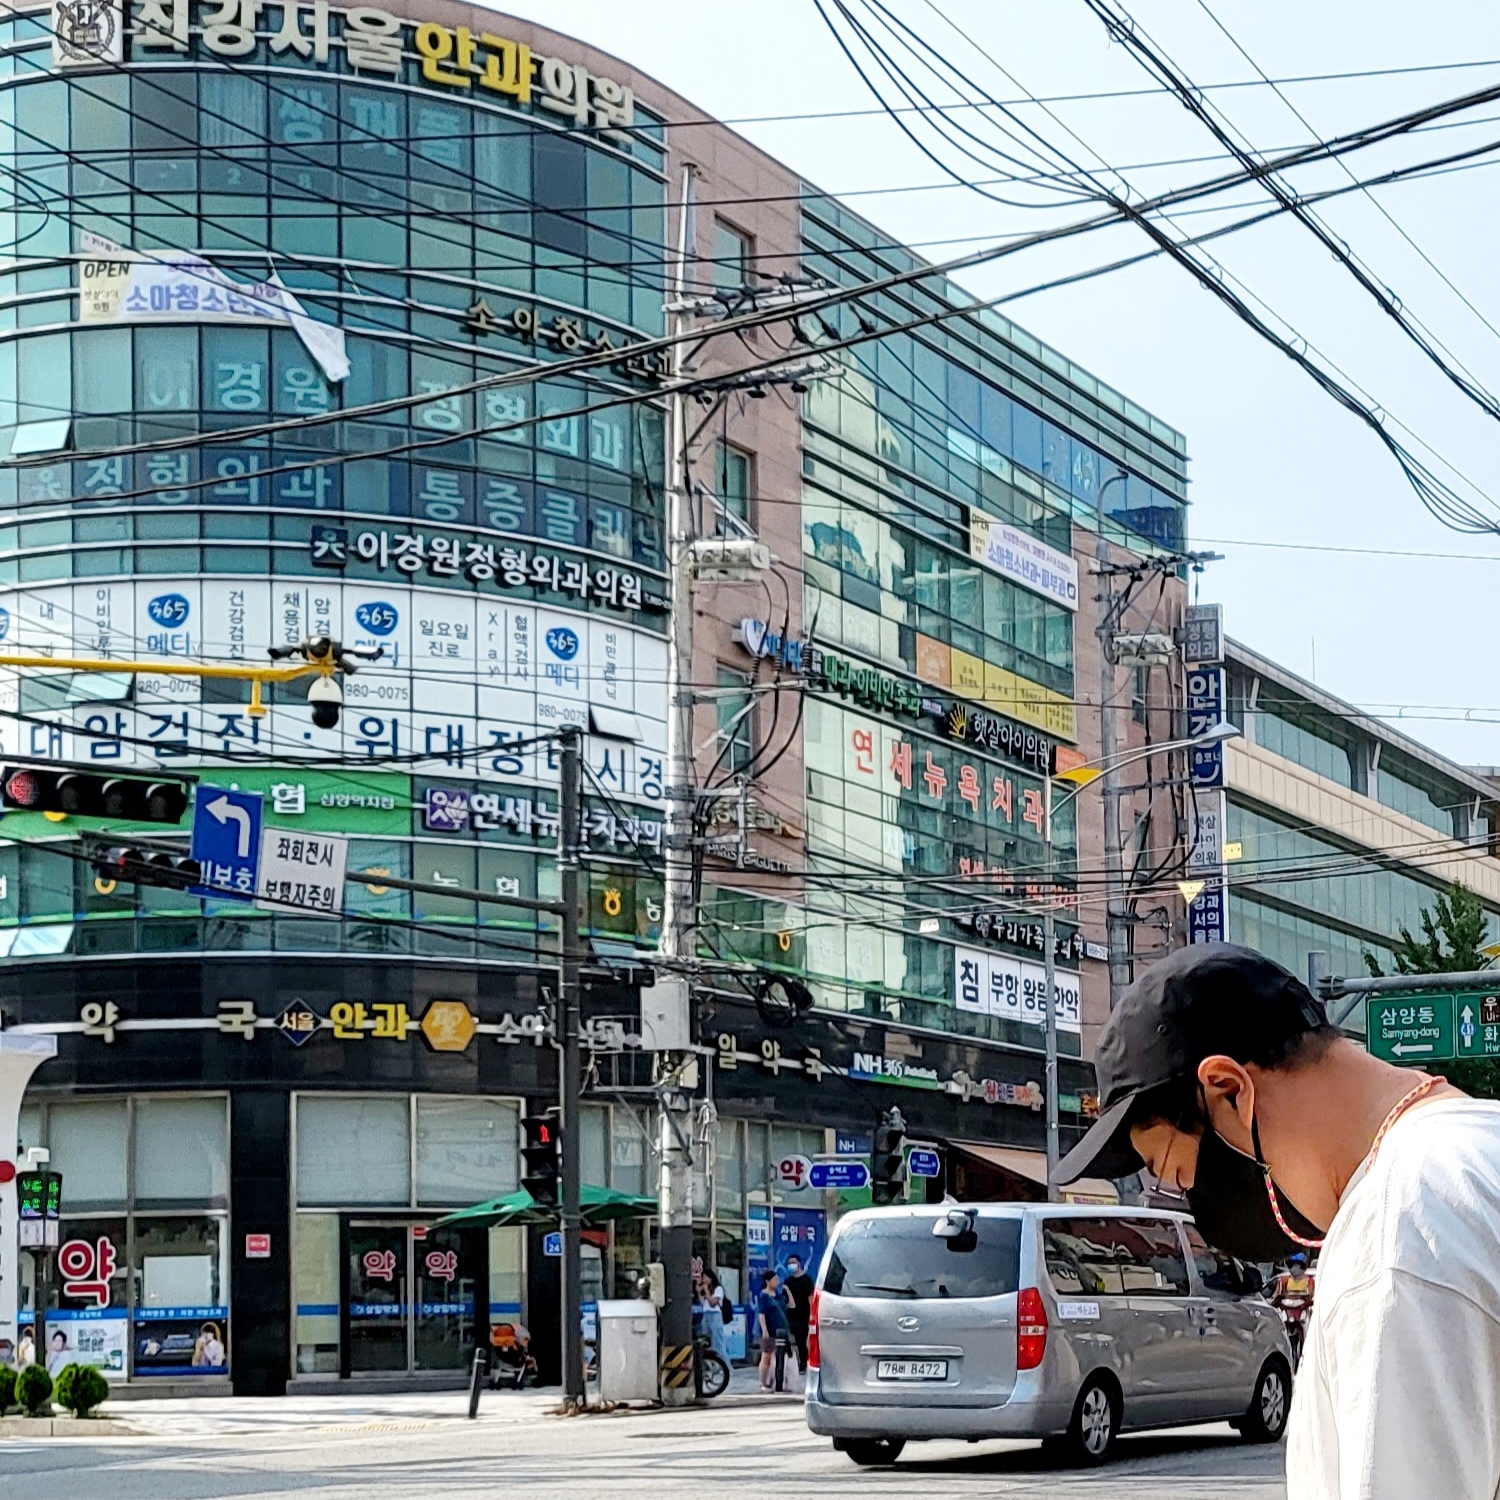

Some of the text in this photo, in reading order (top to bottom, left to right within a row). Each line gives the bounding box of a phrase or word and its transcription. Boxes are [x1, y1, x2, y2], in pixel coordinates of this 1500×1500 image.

[84, 263, 130, 279] OPEN
[357, 533, 643, 610] 이경원정형외과의원
[150, 599, 188, 622] 365
[360, 606, 395, 629] 365
[419, 620, 469, 639] 일요일
[147, 631, 190, 656] 메디
[428, 641, 461, 658] 진료
[548, 631, 577, 654] 365
[545, 663, 580, 690] 메디
[974, 712, 1050, 770] 햇살아이의원
[0, 711, 663, 799] 대암검진 위대장시경
[853, 728, 1045, 834] 연세뉴욕치과
[277, 837, 334, 867] 좌회전시
[706, 843, 738, 861] PARIS
[265, 880, 336, 910] 보행자주의
[960, 960, 979, 1003] 침
[991, 971, 1019, 1006] 부항
[280, 1010, 315, 1032] 서울
[331, 1002, 409, 1040] 안과
[1380, 1006, 1435, 1026] 삼양동
[1381, 1027, 1440, 1041] Samyang-dong
[853, 1052, 882, 1074] NH
[839, 1139, 856, 1152] NH
[781, 1160, 805, 1187] 약
[59, 1236, 116, 1309] 약
[364, 1250, 396, 1281] 약
[426, 1251, 458, 1281] 약
[911, 1363, 940, 1375] 8472
